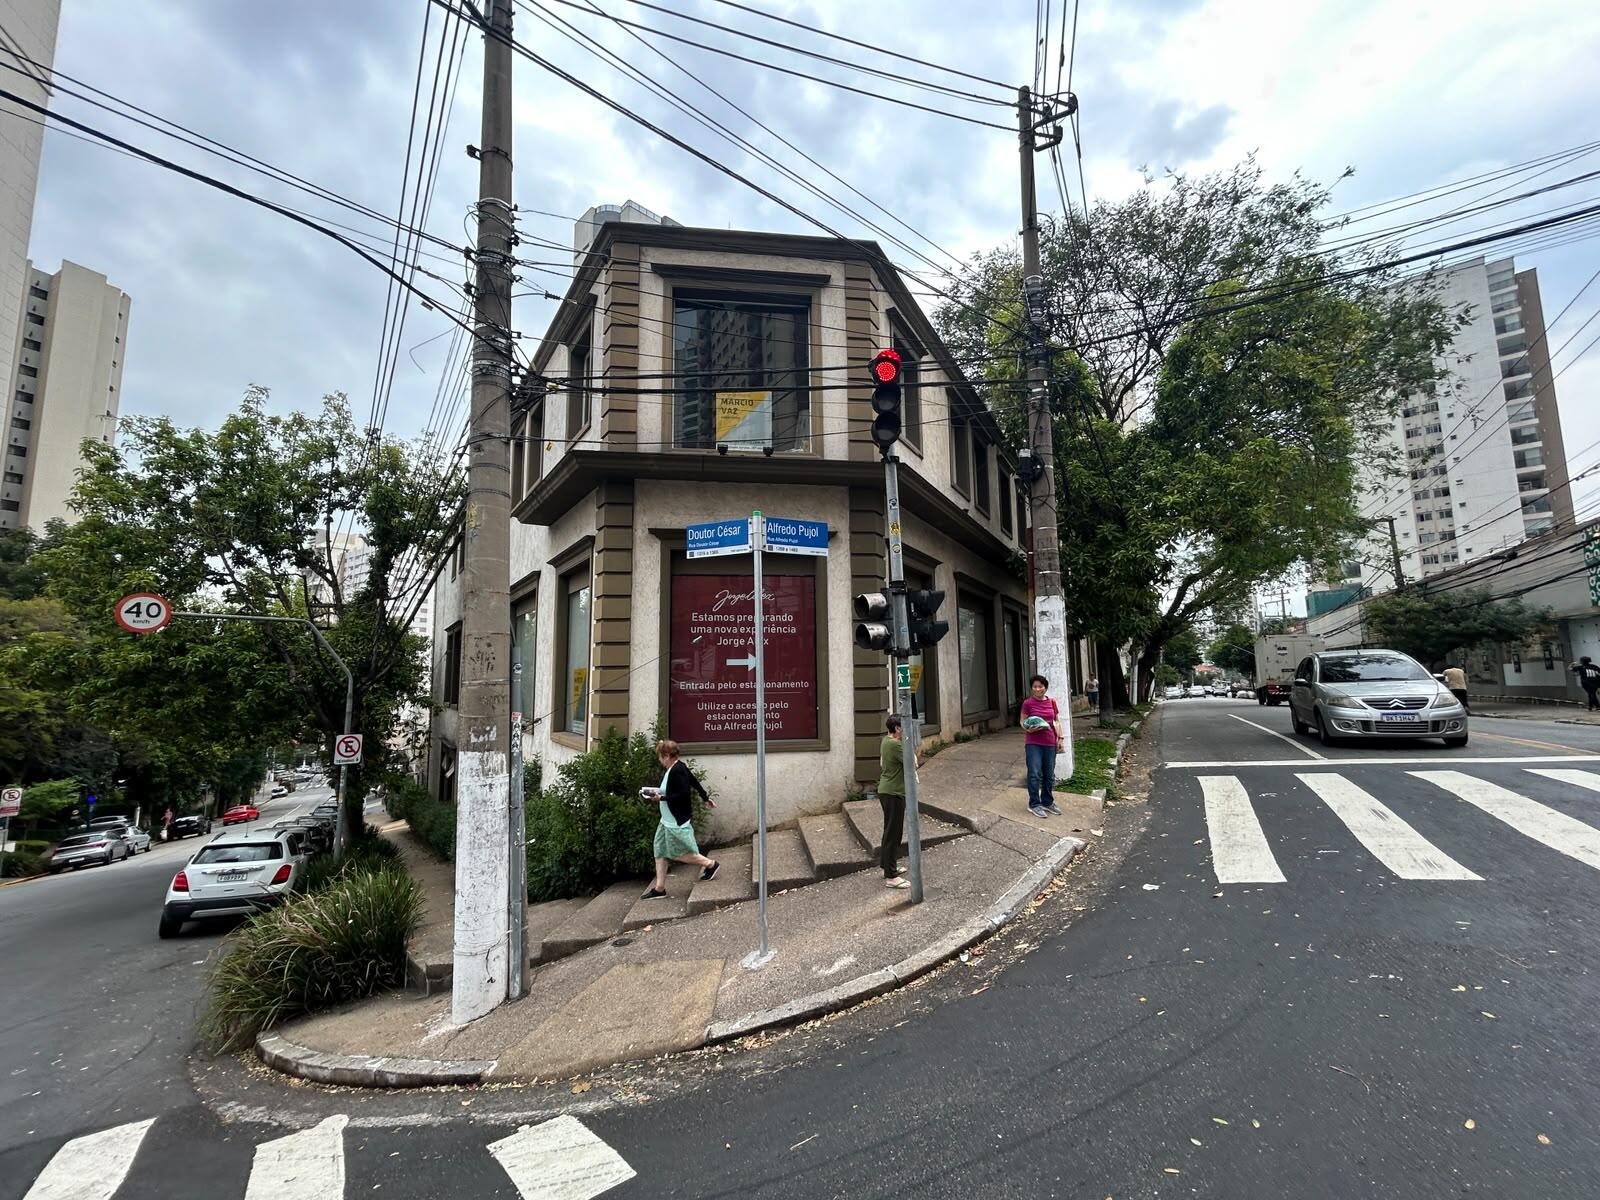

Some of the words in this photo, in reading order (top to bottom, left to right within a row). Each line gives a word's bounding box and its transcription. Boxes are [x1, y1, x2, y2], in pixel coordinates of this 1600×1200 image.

[721, 407, 738, 415] VAZ
[688, 529, 715, 541] Doutor
[717, 526, 741, 537] César
[767, 522, 797, 535] Alfredo
[799, 525, 819, 539] Pujol
[124, 601, 162, 618] 40
[691, 612, 735, 622] Estamos
[737, 612, 794, 623] prerando
[690, 625, 712, 634] uma
[714, 625, 738, 634] nova
[739, 624, 797, 635] expriência
[717, 636, 745, 647] Jorge
[747, 636, 769, 645] Ax
[680, 681, 715, 690] Entrada
[718, 681, 737, 690] pelo
[740, 680, 809, 689] estaionamento
[697, 702, 726, 710] Utilize
[769, 701, 789, 710] pelo
[704, 722, 722, 731] Rua
[723, 722, 757, 730] Alfredo
[763, 721, 783, 731] ujol
